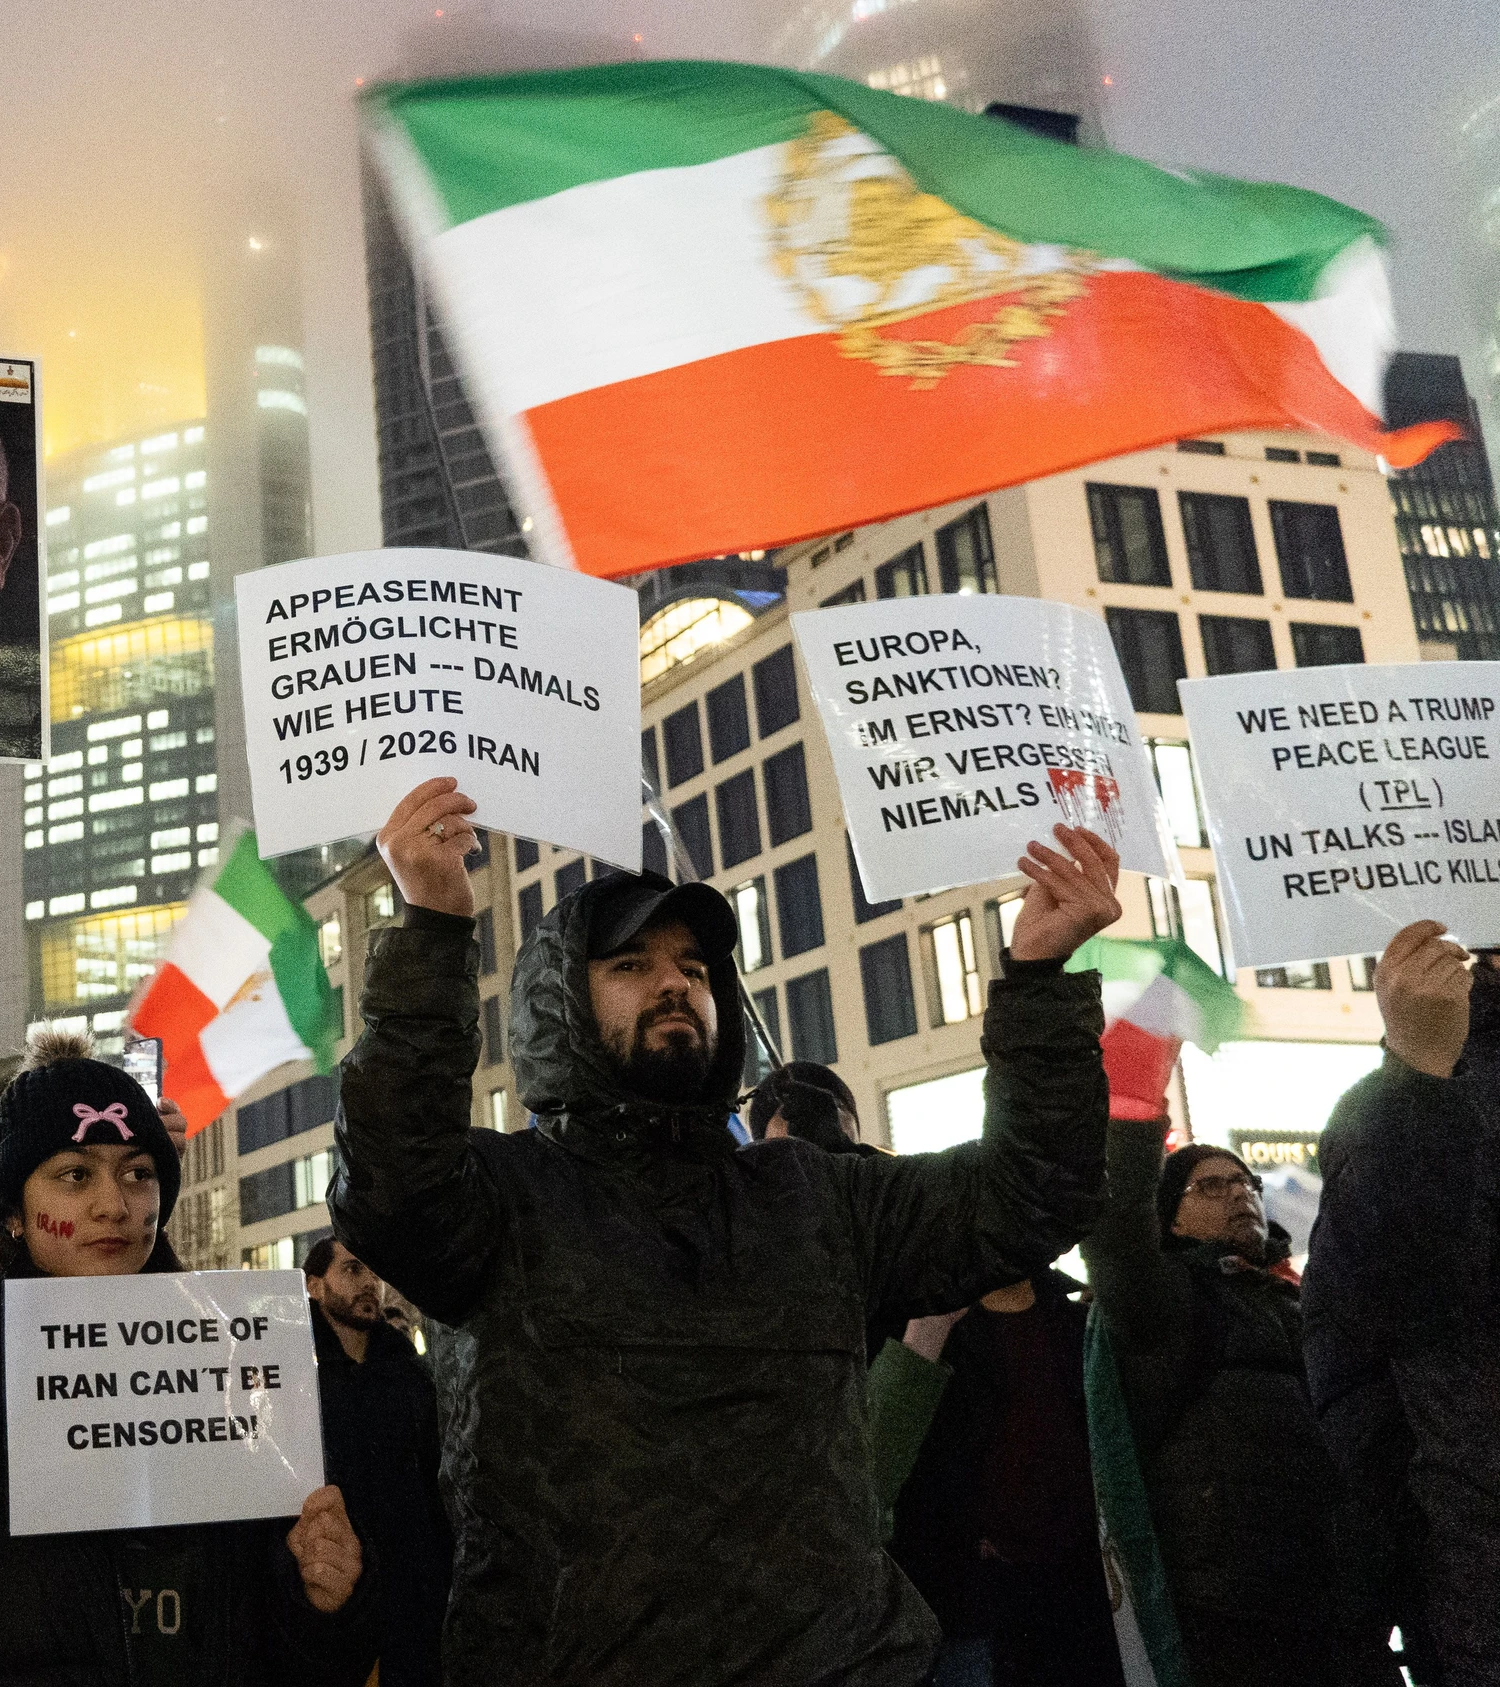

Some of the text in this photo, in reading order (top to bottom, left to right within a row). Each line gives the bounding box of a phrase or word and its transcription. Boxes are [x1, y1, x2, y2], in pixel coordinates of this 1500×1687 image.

[266, 579, 523, 624] APPEASEMENT
[268, 616, 518, 662] ERMÖGLICHTE
[833, 629, 981, 666] EUROPA,
[271, 653, 417, 700] GRAUEN
[474, 656, 600, 711] DAMALS
[845, 664, 1060, 704] SANKTIONEN?
[273, 690, 464, 741] WIE HEUTE
[906, 703, 1031, 739] ERNST?
[1236, 697, 1495, 733] WE NEED A TRUMP
[279, 730, 540, 784] 1939 / 2026 IRAN
[1272, 736, 1490, 771] PEACE LEAGUE
[866, 756, 940, 791] WIR
[881, 782, 1040, 832] NIEMALS
[1246, 833, 1293, 860] UN
[1301, 822, 1405, 854] TALKS
[1283, 860, 1442, 899] REPUBLIC
[1241, 1141, 1305, 1164] LOUIS
[36, 1212, 75, 1239] IRAN
[41, 1317, 268, 1350] THE VOICE OF
[36, 1373, 118, 1401] IRAN
[241, 1365, 281, 1389] BE
[66, 1415, 259, 1449] CENSORED!
